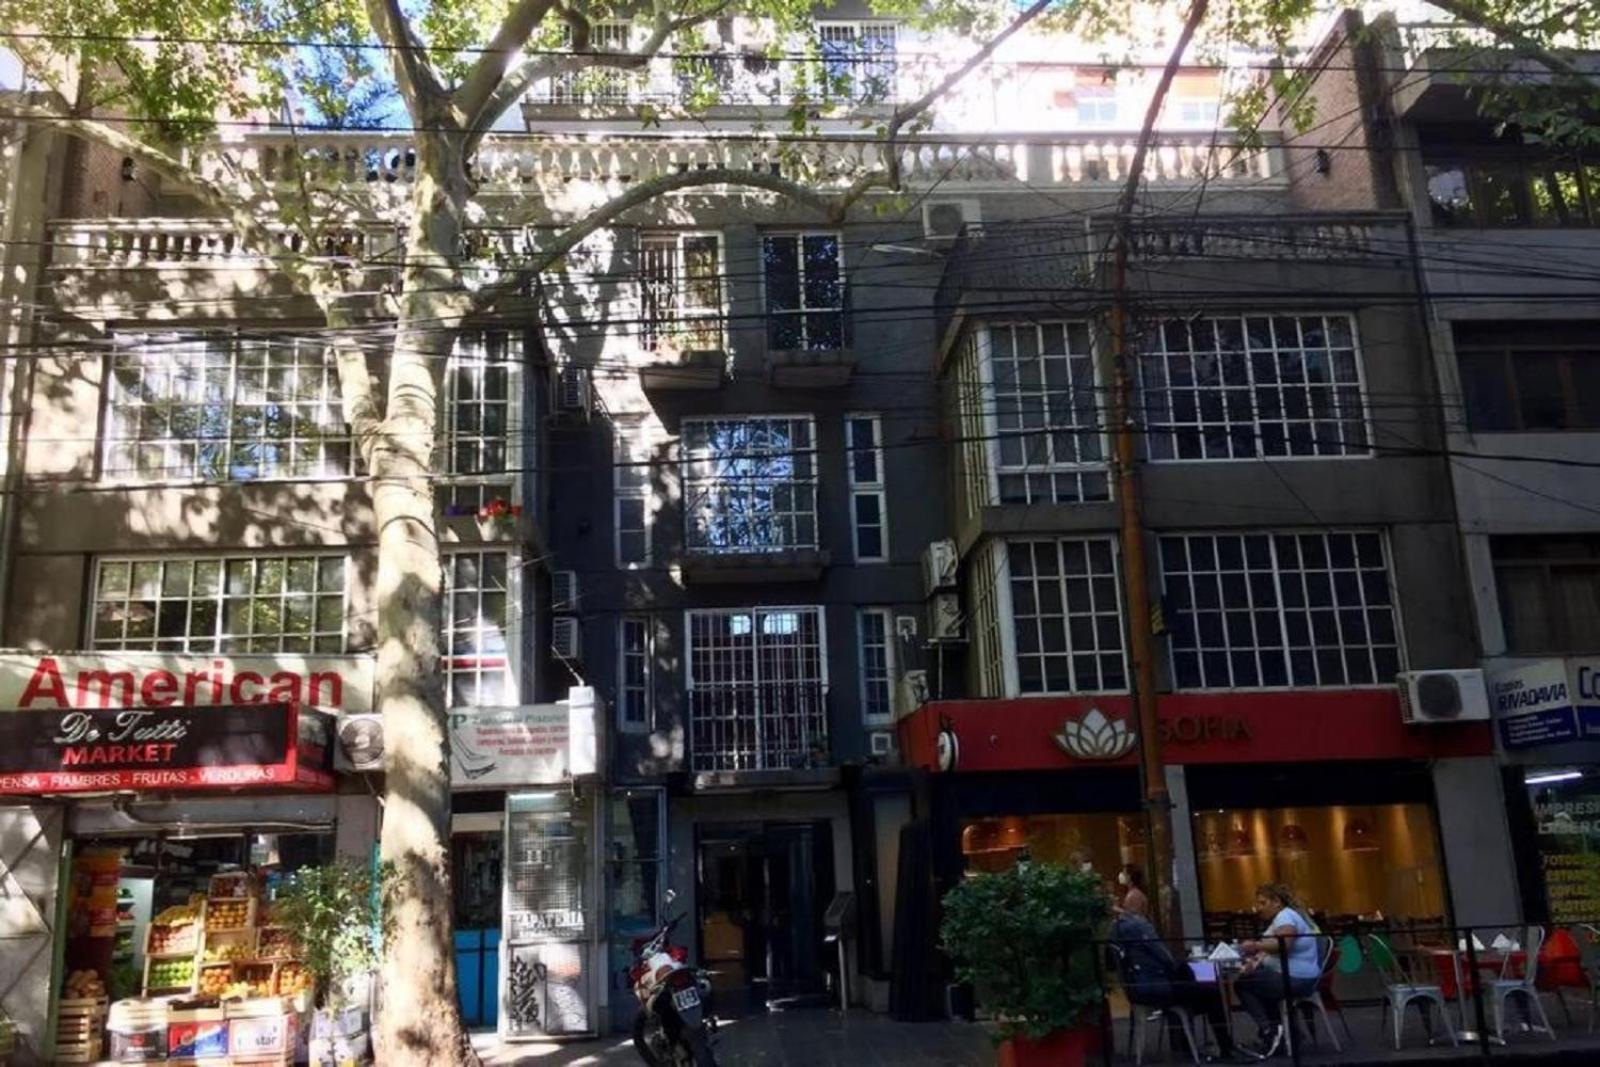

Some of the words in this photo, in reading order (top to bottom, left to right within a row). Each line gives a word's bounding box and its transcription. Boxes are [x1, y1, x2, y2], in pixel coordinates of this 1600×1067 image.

[18, 656, 343, 708] American
[53, 711, 99, 744] De
[108, 710, 191, 743] Tutti
[62, 744, 179, 765] MARKET
[0, 775, 41, 789] ENSA
[132, 770, 188, 784] FRUTAS
